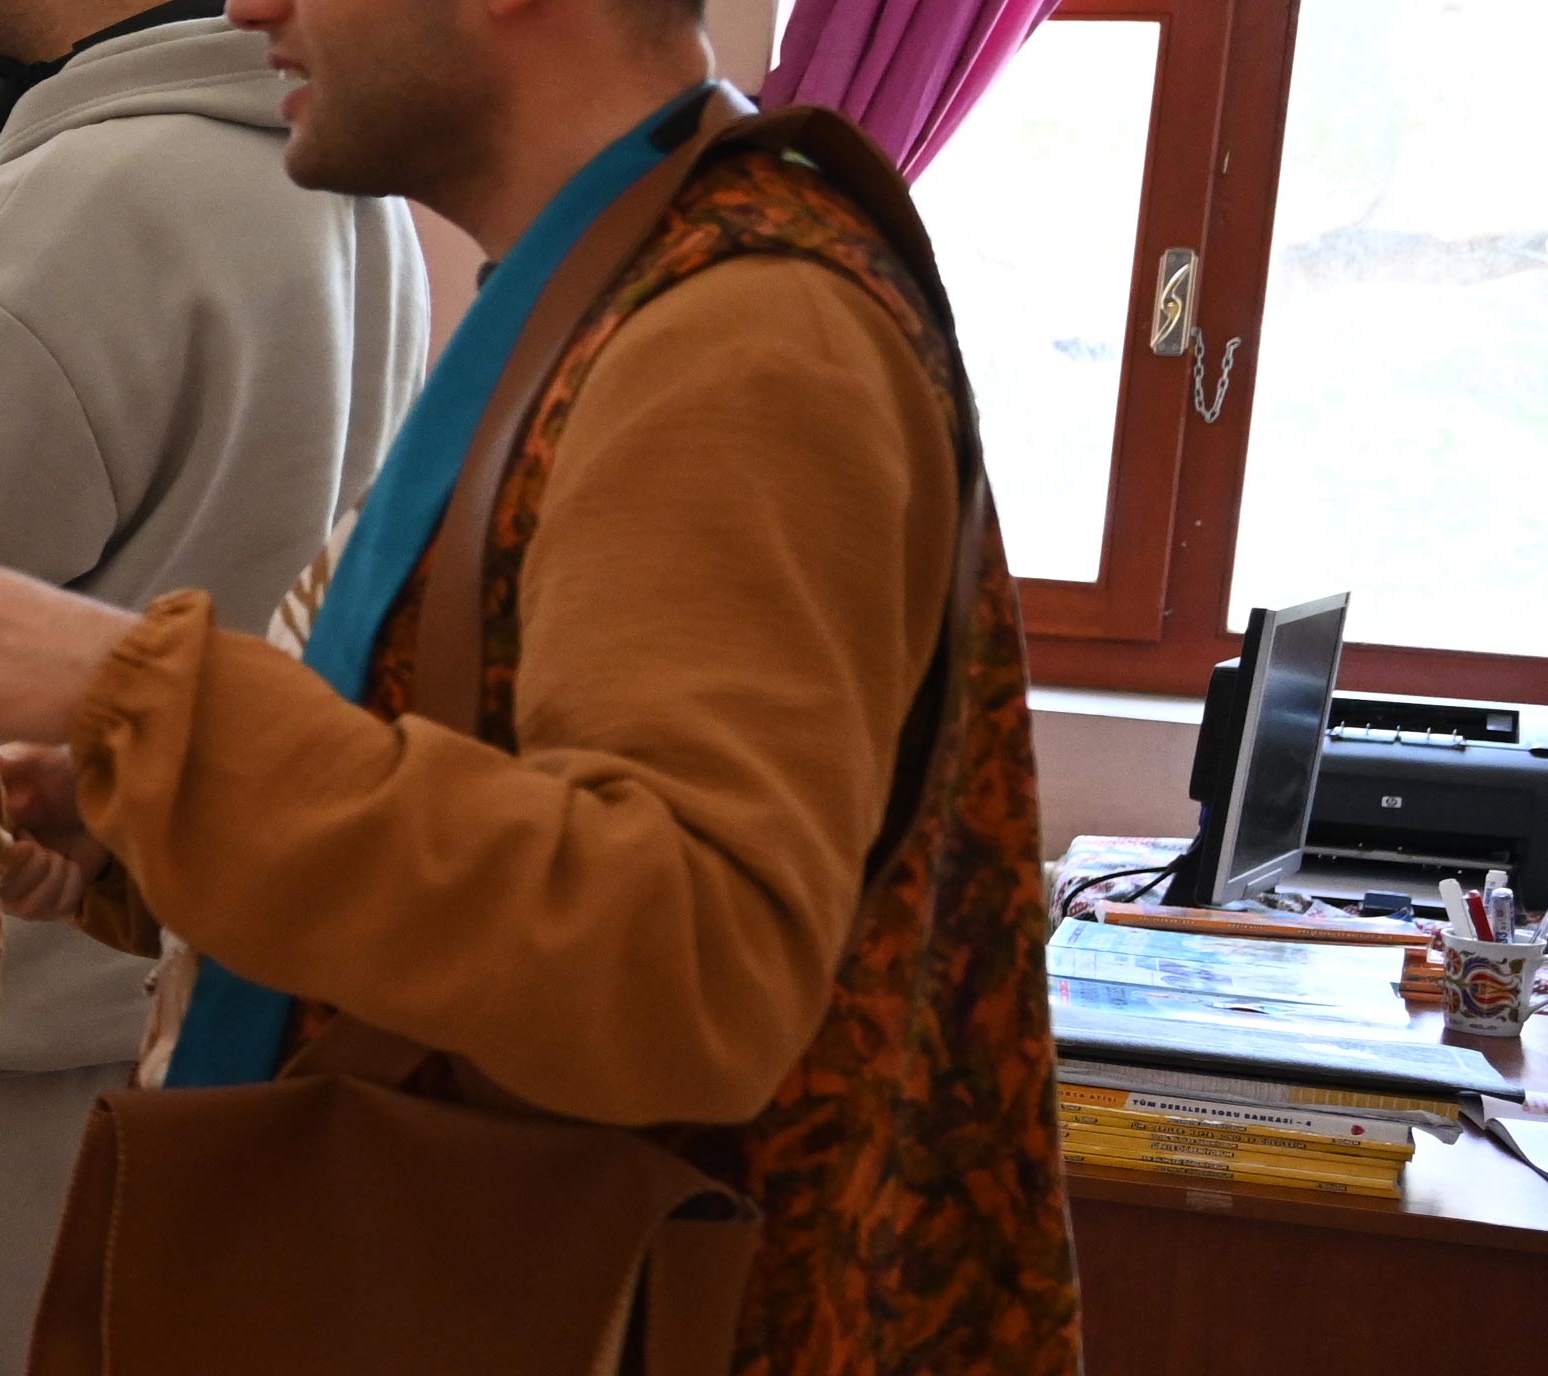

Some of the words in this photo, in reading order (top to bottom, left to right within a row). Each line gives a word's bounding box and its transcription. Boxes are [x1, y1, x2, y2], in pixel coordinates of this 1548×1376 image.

[1132, 1098, 1156, 1109] TÜM
[1160, 1103, 1207, 1115] DERSLER
[1211, 1108, 1241, 1119] SORU
[1244, 1113, 1293, 1125] BANKASI
